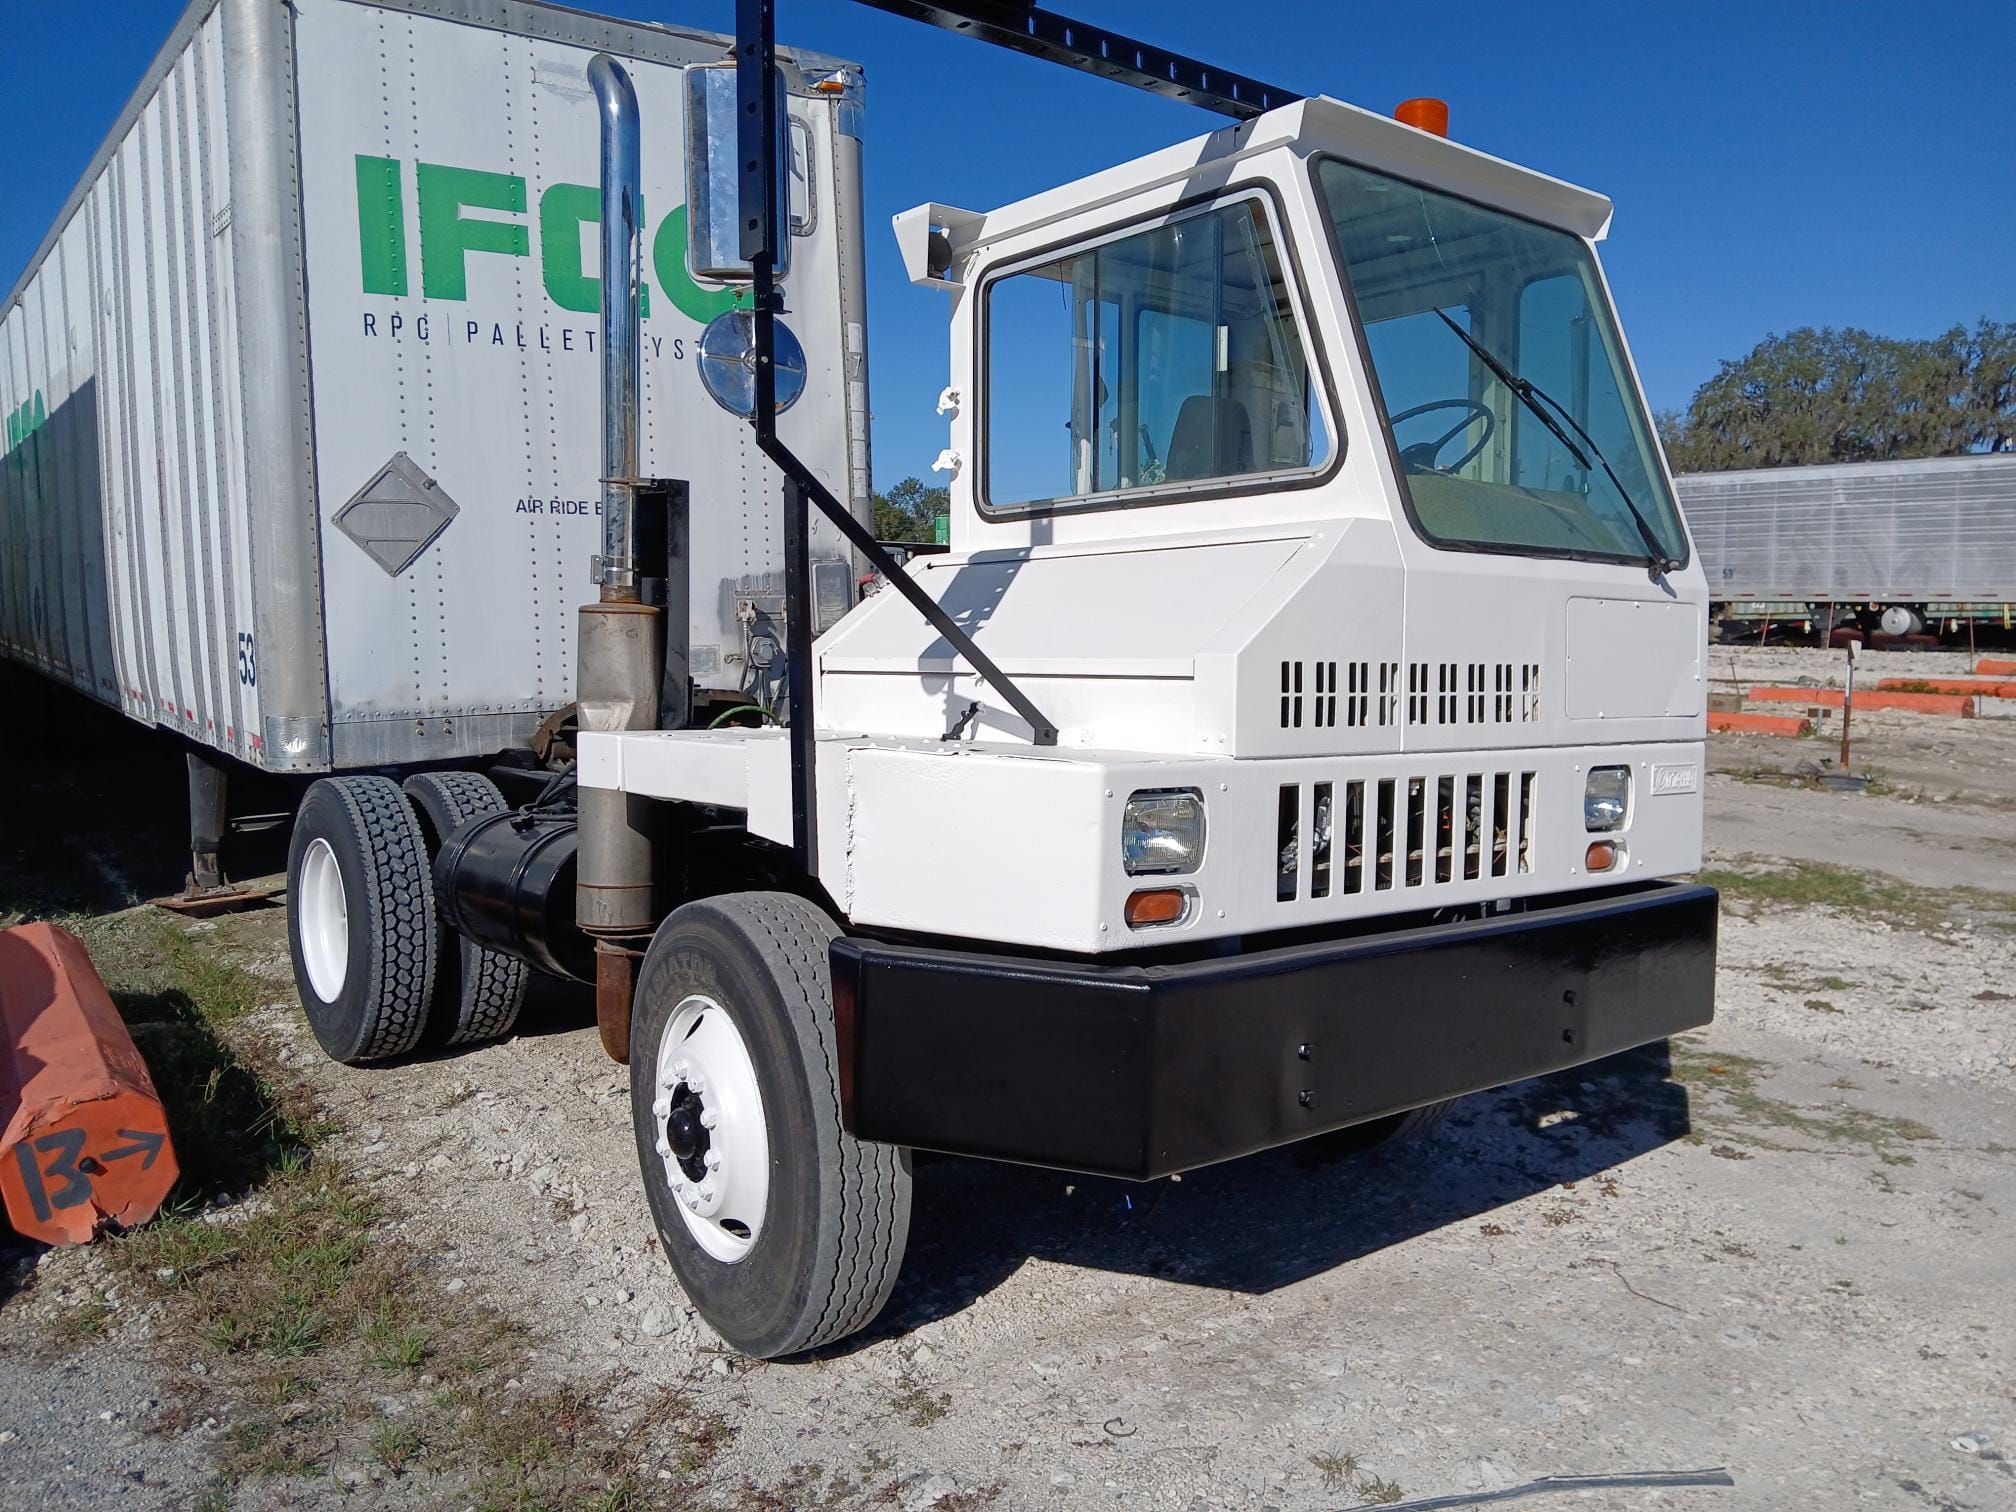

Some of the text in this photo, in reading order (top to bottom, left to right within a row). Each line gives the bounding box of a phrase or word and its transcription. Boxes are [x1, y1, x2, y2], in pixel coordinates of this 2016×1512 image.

[364, 312, 430, 341] RPC
[466, 320, 597, 354] PALLET
[515, 498, 544, 514] AIR
[550, 500, 589, 516] RIDE
[238, 632, 256, 688] 53
[15, 1127, 93, 1224] 13
